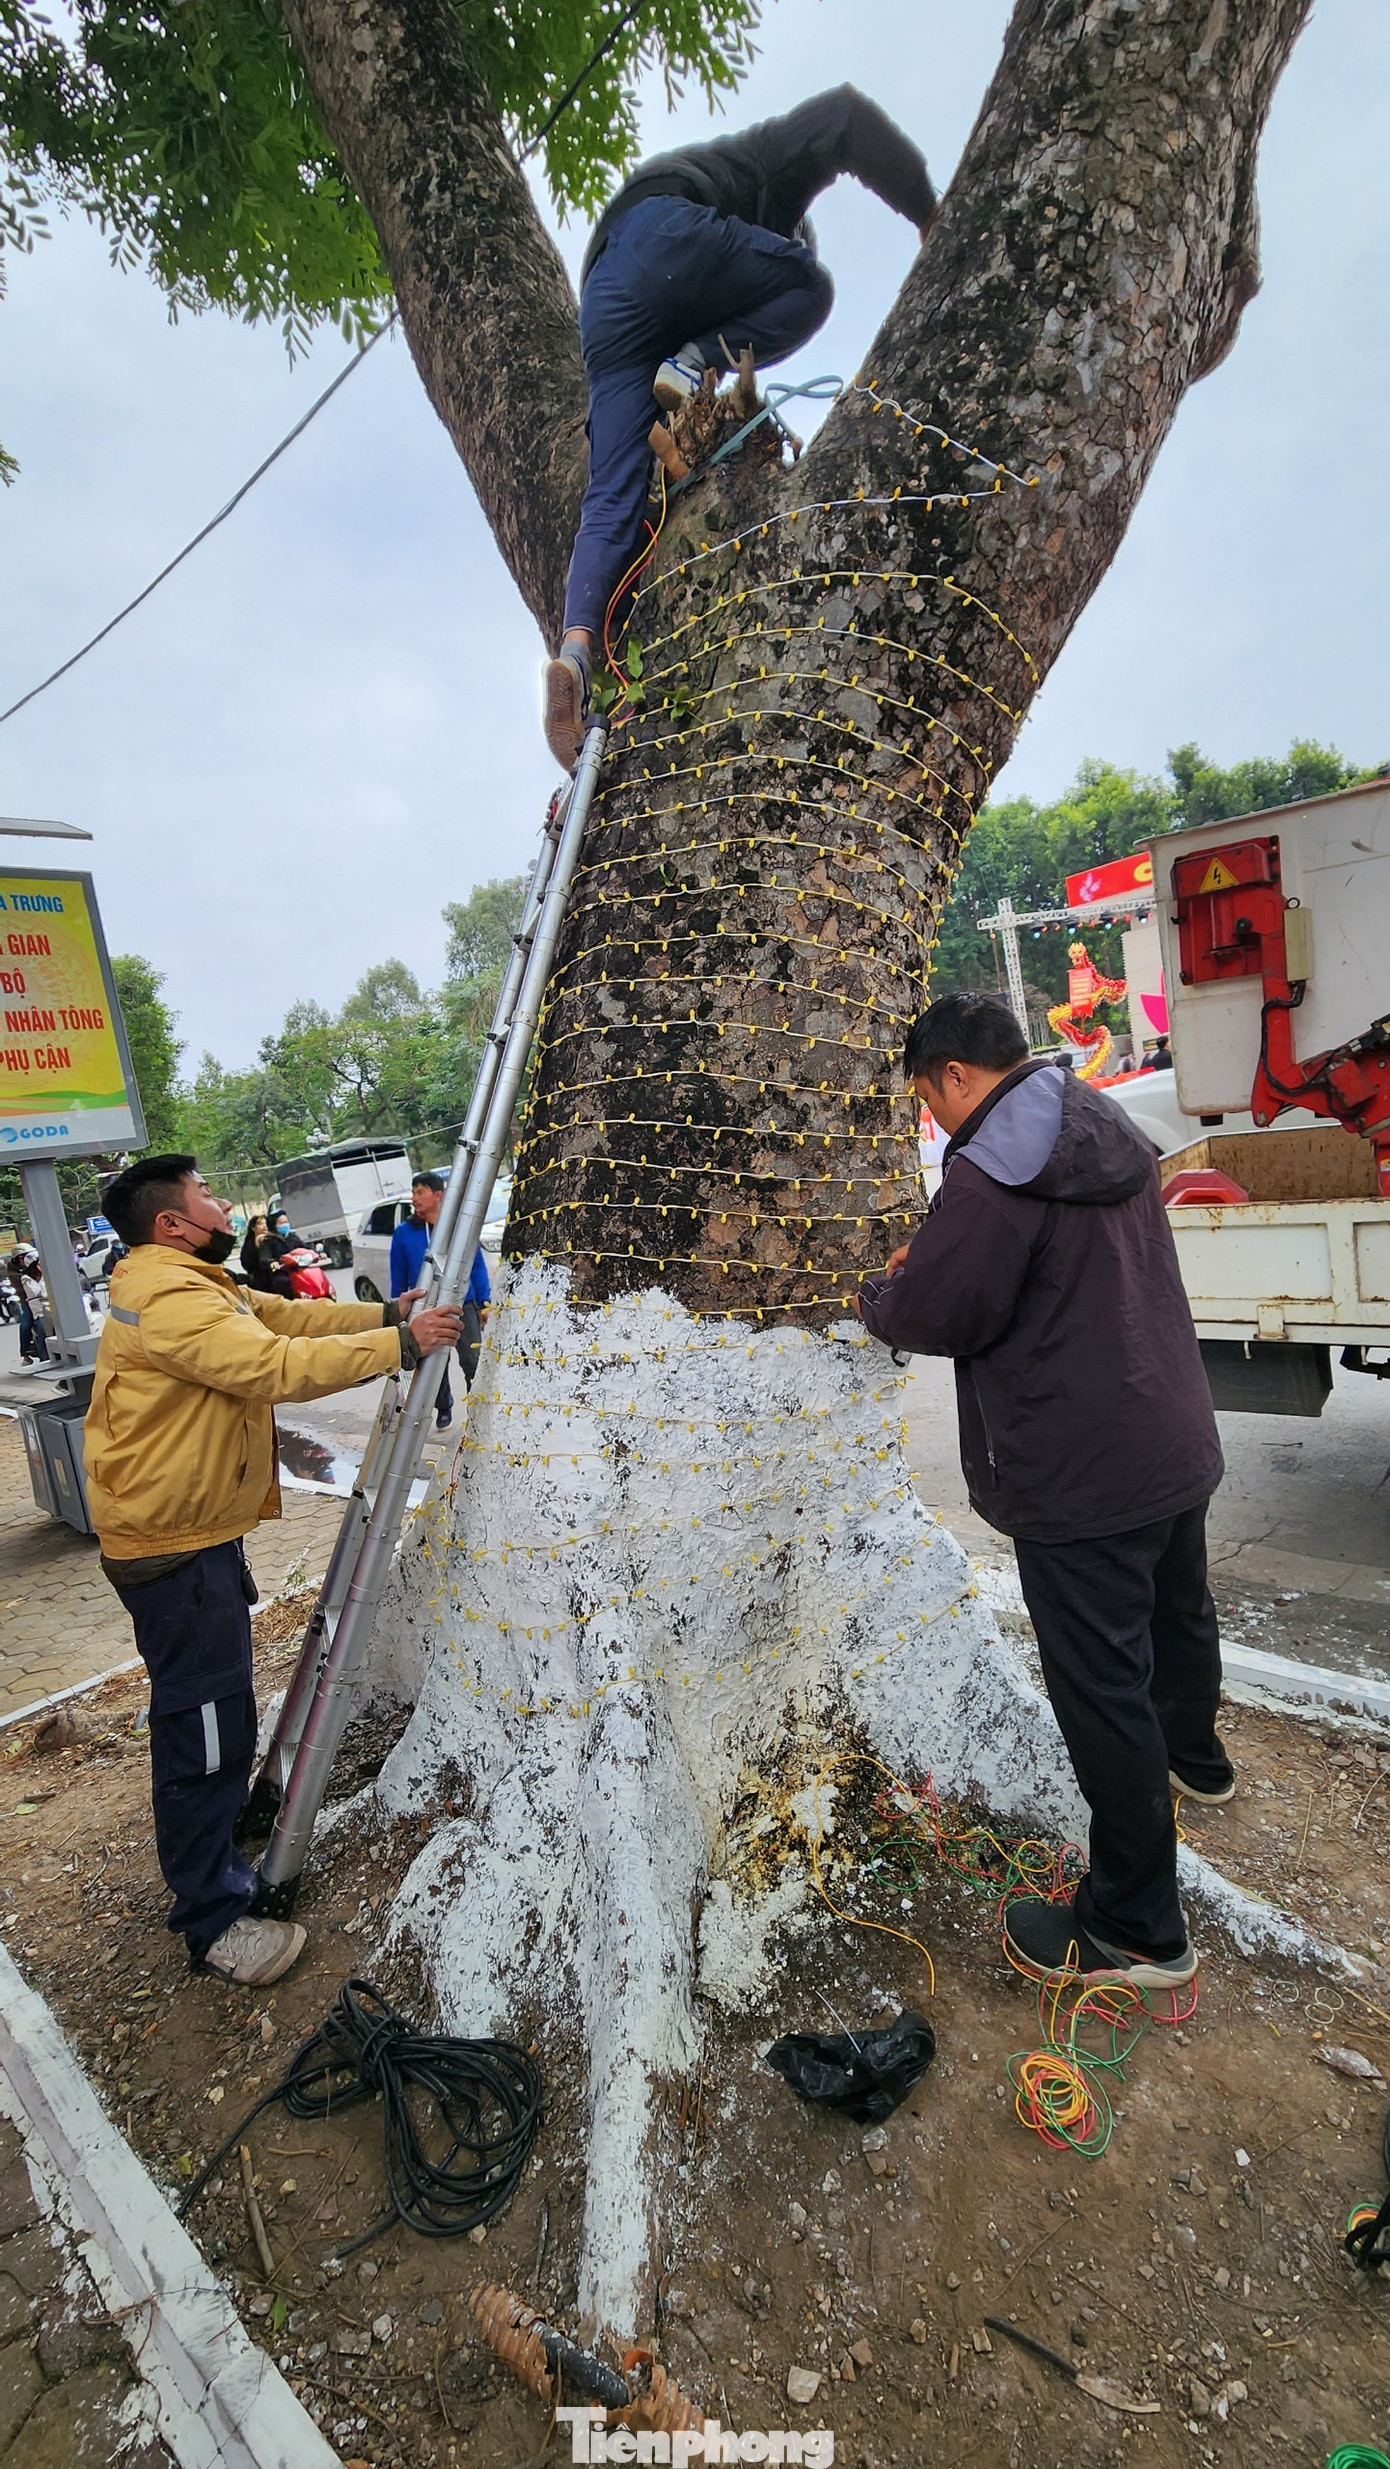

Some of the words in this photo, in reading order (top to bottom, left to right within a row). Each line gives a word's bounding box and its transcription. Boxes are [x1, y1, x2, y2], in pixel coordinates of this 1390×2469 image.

[9, 894, 64, 913] TRƯNG
[7, 933, 51, 956] GIAN
[0, 967, 26, 999] BỘ
[4, 1005, 56, 1033] NHÂN
[58, 1004, 104, 1031] TÔNG
[33, 1043, 71, 1073] CẬN
[20, 1124, 69, 1139] GODA
